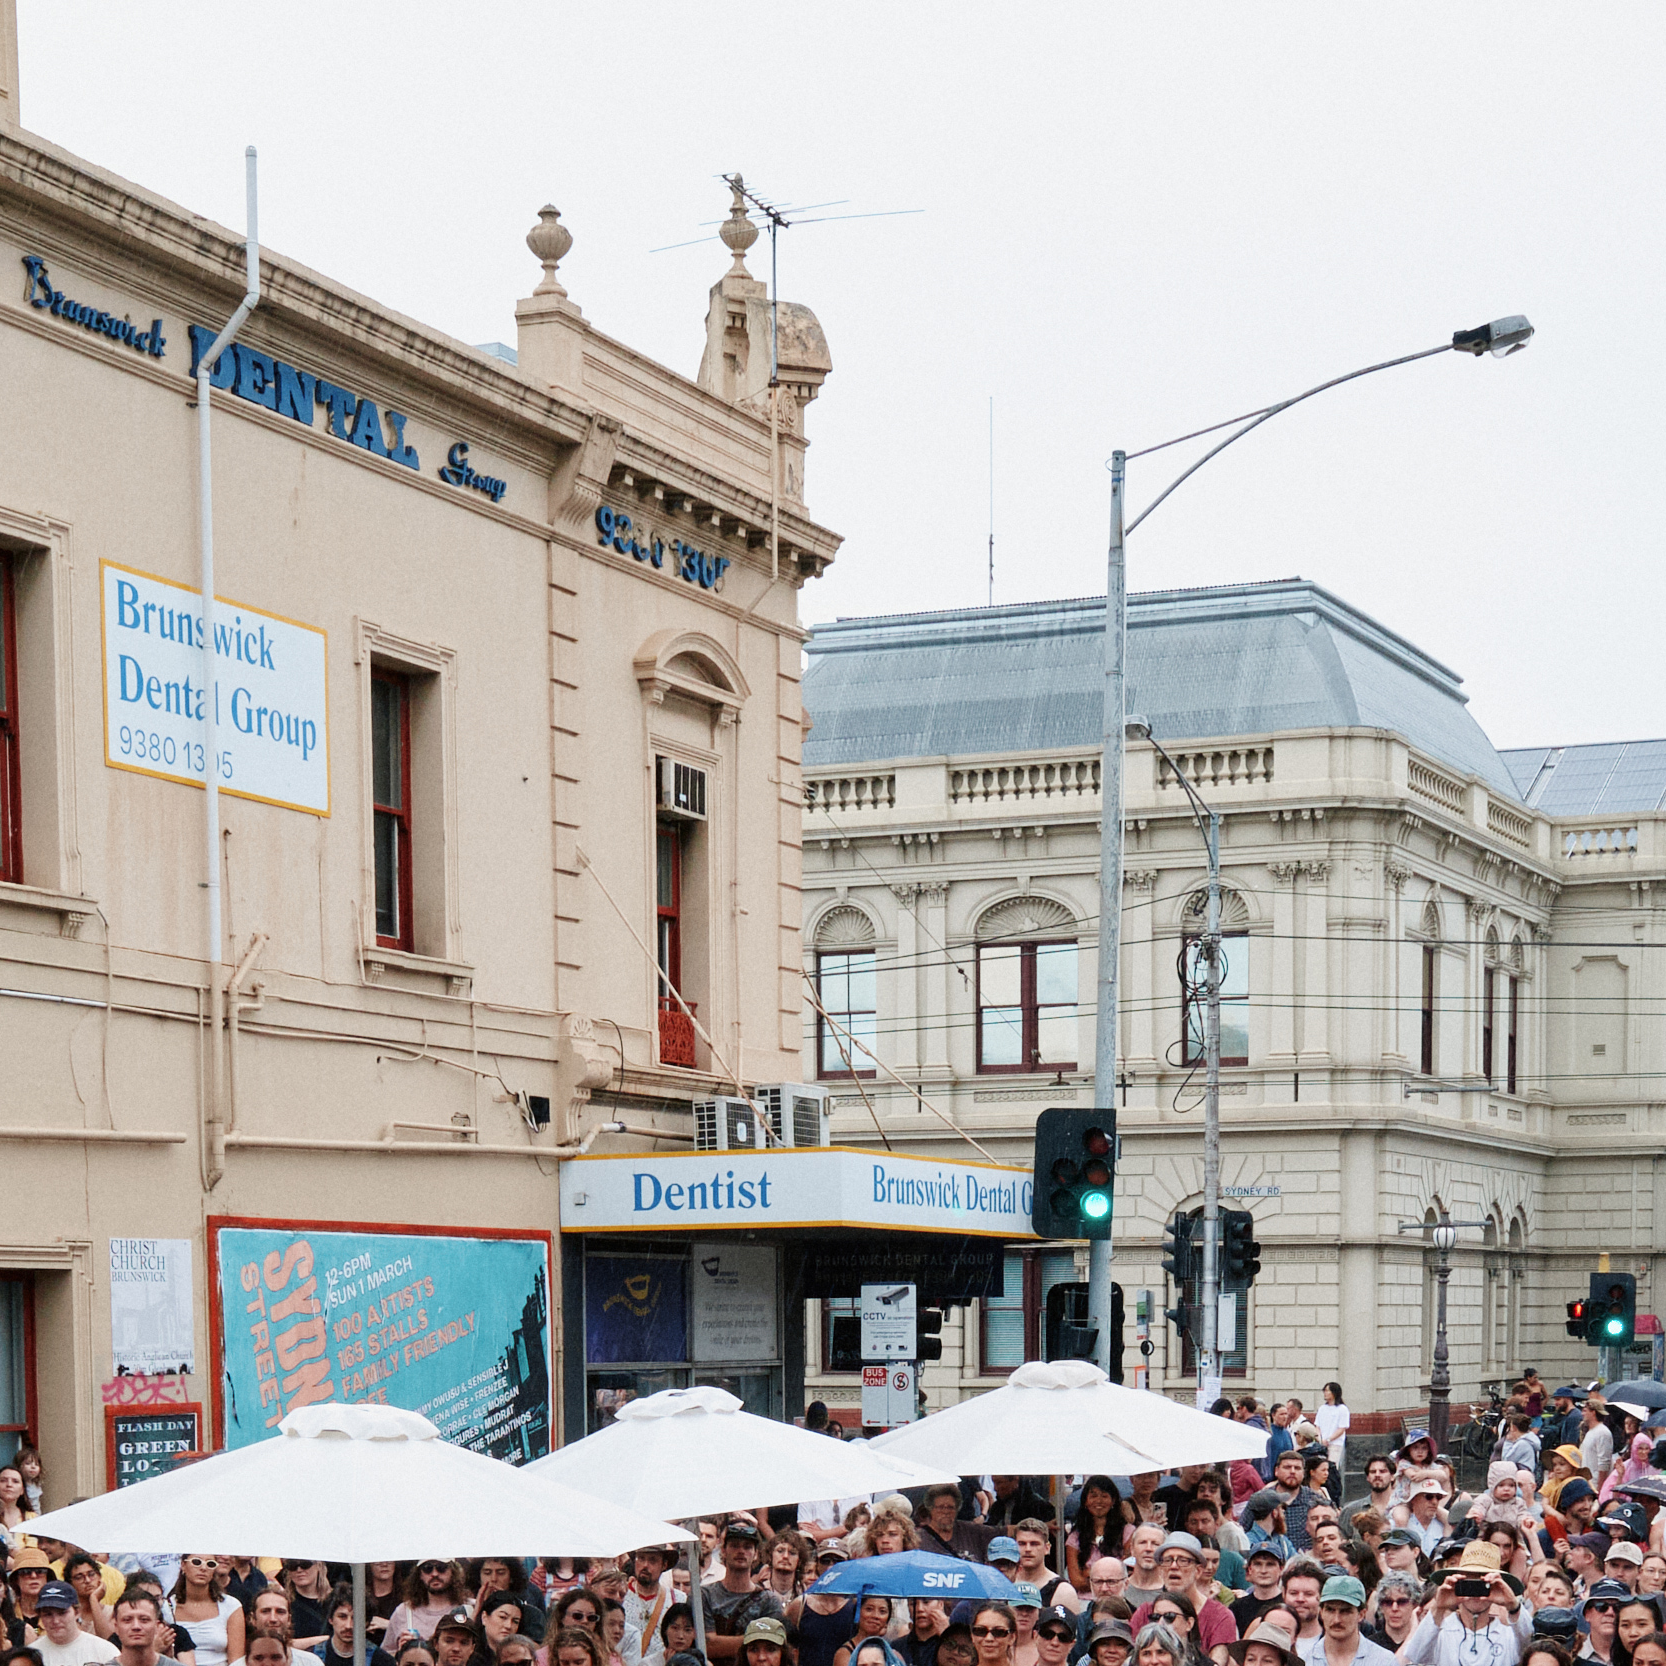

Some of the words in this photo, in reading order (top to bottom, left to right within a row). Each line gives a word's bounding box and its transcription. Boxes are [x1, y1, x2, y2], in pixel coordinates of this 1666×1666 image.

[21, 256, 168, 358] Brunswick
[189, 323, 419, 470] DENTAL
[436, 442, 506, 503] Group
[229, 687, 316, 761] Group
[119, 725, 176, 765] 9380
[182, 741, 233, 779] 135
[632, 1170, 772, 1212] Dentist
[872, 1164, 961, 1210] Brunswick
[965, 1174, 1016, 1214] Dental
[1224, 1186, 1264, 1197] SYDNEY
[1267, 1186, 1280, 1196] RD
[110, 1240, 158, 1255] CHRIST
[110, 1255, 166, 1270] CHURCH
[324, 1251, 373, 1285] 12-6PM
[111, 1271, 166, 1283] BRUNSWICK
[329, 1287, 357, 1309] SUN
[366, 1254, 414, 1294] MARCH
[262, 1239, 335, 1411] SYDN
[332, 1311, 363, 1344] 100
[366, 1275, 436, 1325] ARTISTS
[862, 1312, 887, 1320] CCTV
[240, 1261, 284, 1429] STREET
[336, 1341, 365, 1372] 165
[367, 1307, 429, 1358] STALLS
[340, 1352, 400, 1398] FAMILY
[403, 1310, 477, 1367] FRIENDLY
[433, 1386, 461, 1408] OWUSU
[467, 1362, 504, 1390] SENSIBLE
[863, 1377, 887, 1386] ZONE
[866, 1368, 884, 1377] BUS
[450, 1397, 470, 1415] WISE
[474, 1376, 509, 1400] FRENZEE
[487, 1385, 520, 1412] MORGAN
[117, 1422, 163, 1432] FLASH
[167, 1420, 194, 1430] DAY
[469, 1438, 485, 1453] THE
[485, 1410, 532, 1446] TARANTINOS
[484, 1404, 515, 1430] MUDRAT
[119, 1439, 191, 1455] GREEN
[922, 1572, 966, 1589] SNF
